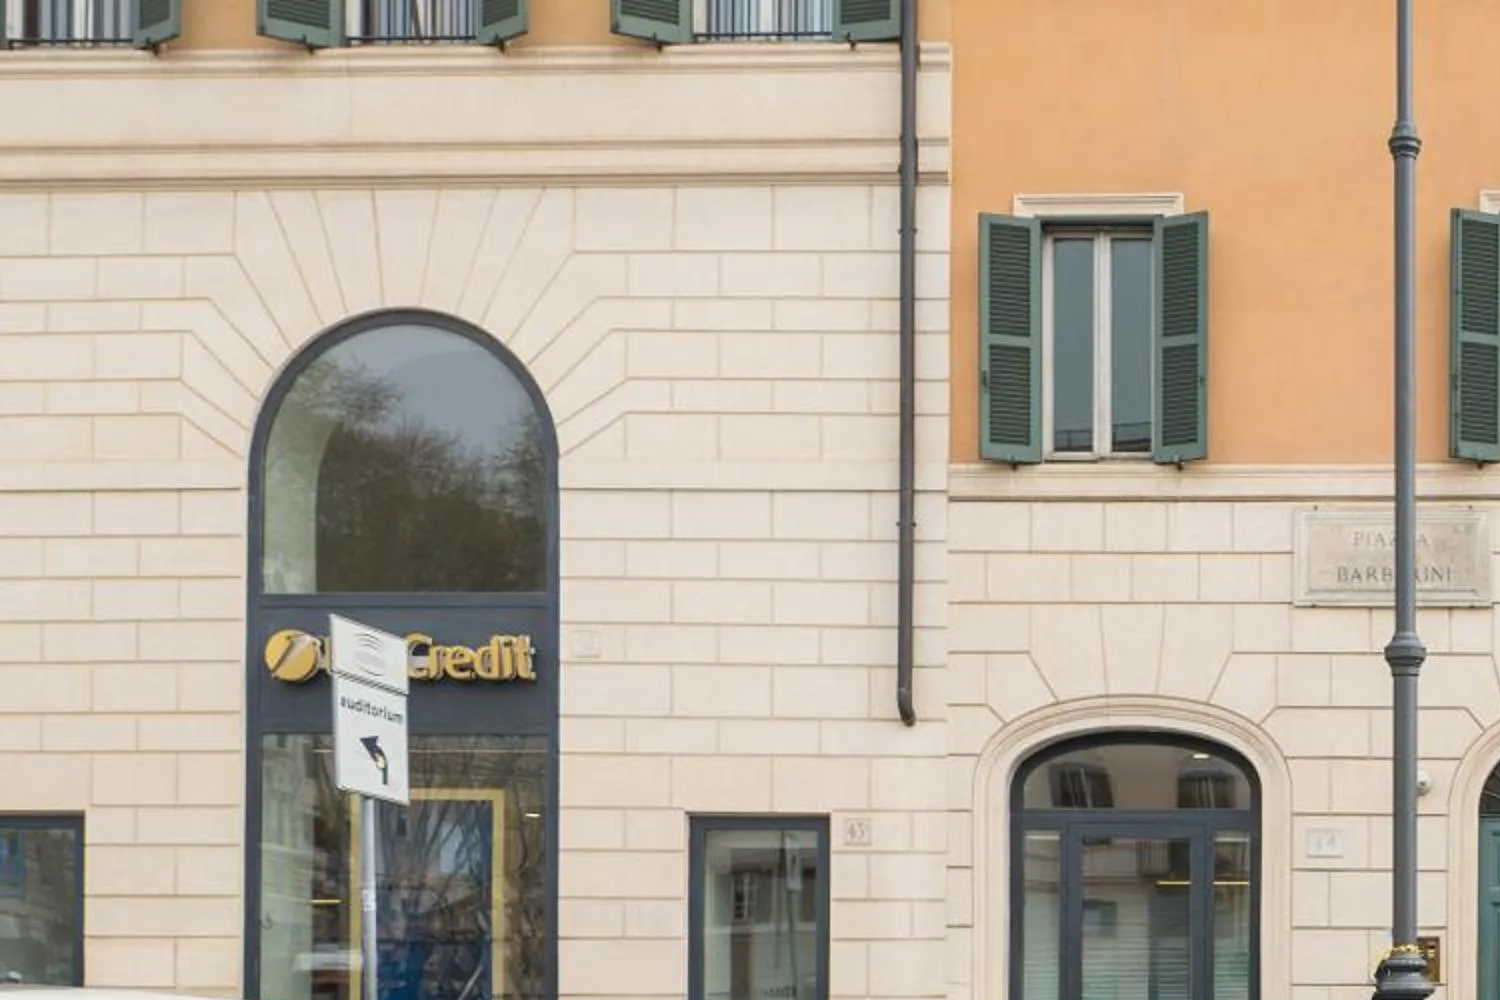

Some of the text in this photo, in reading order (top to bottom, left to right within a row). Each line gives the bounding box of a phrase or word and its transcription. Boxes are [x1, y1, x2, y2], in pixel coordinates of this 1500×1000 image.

[1353, 530, 1431, 547] PIAA
[323, 632, 536, 681] Credit
[340, 696, 404, 724] auditorium
